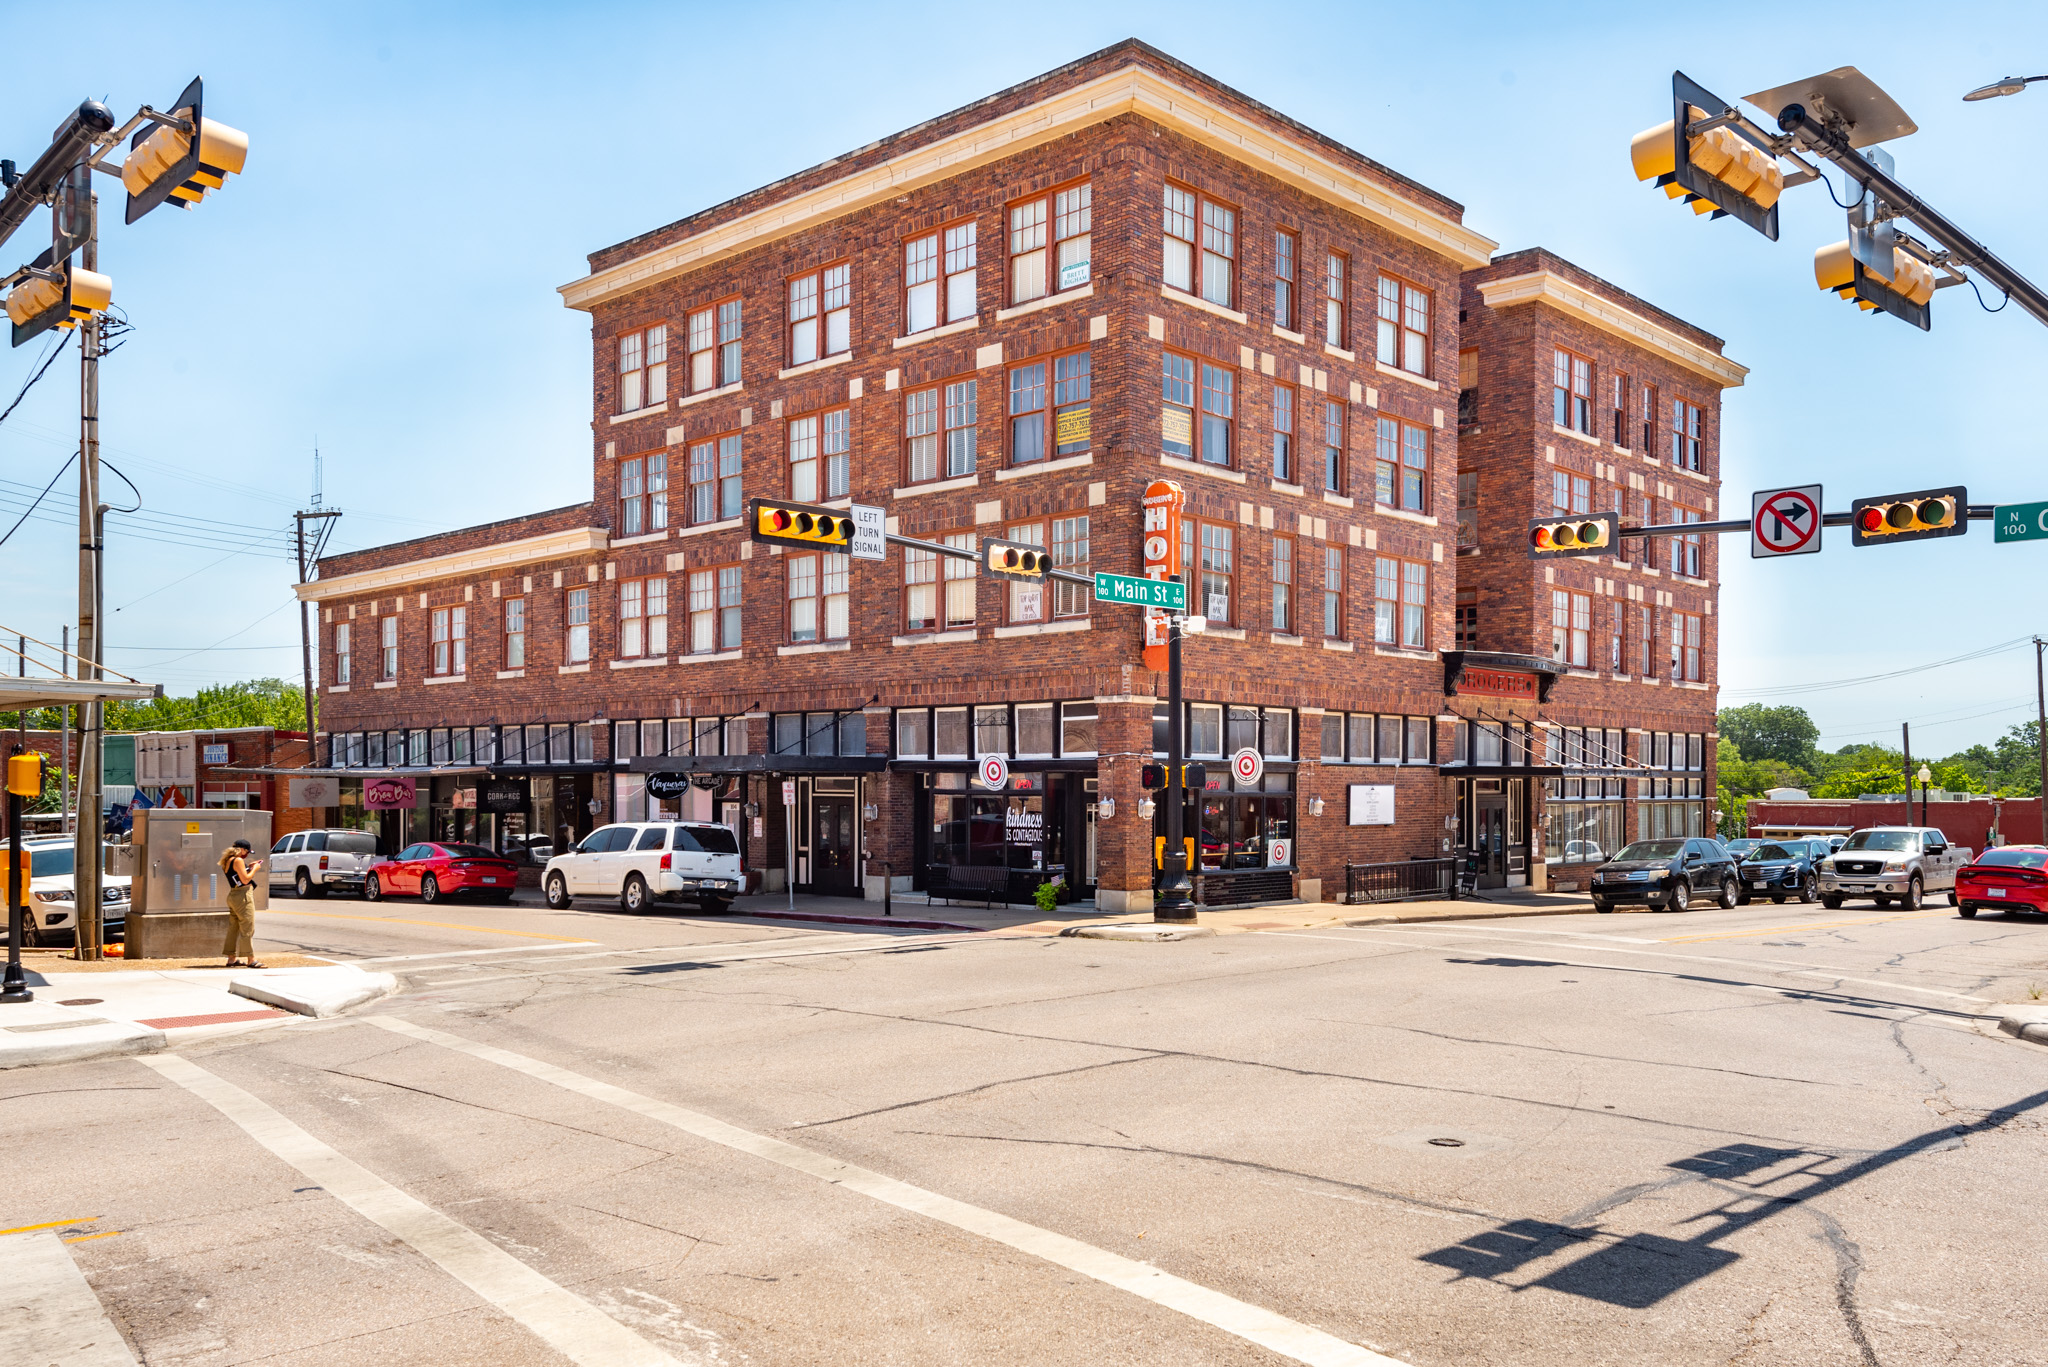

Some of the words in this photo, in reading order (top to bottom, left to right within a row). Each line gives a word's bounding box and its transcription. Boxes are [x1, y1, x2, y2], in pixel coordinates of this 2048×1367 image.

[1067, 270, 1084, 279] BRETT
[1064, 275, 1087, 286] BIGHAM
[858, 511, 877, 523] LEFT
[2010, 511, 2019, 522] N
[858, 526, 879, 538] TURN
[2003, 523, 2027, 535] 100
[854, 541, 883, 554] SIGNAL
[1100, 578, 1106, 586] W
[1098, 587, 1109, 596] 100
[1114, 580, 1148, 601] Main
[1154, 585, 1168, 603] St
[1173, 596, 1183, 604] 100
[1467, 671, 1526, 693] ROGERS
[204, 753, 228, 763] FINANCE
[648, 777, 688, 791] Vaqueras
[692, 777, 700, 785] THE
[701, 777, 720, 785] ARCADE
[1015, 779, 1033, 789] OPEN
[1205, 780, 1220, 790] OPEN
[394, 785, 413, 800] Bar
[487, 792, 504, 800] CORK
[508, 792, 521, 800] KEG
[1006, 806, 1042, 828] kindness
[1006, 829, 1011, 841] IS
[1012, 828, 1042, 842] CONTAGIOUS
